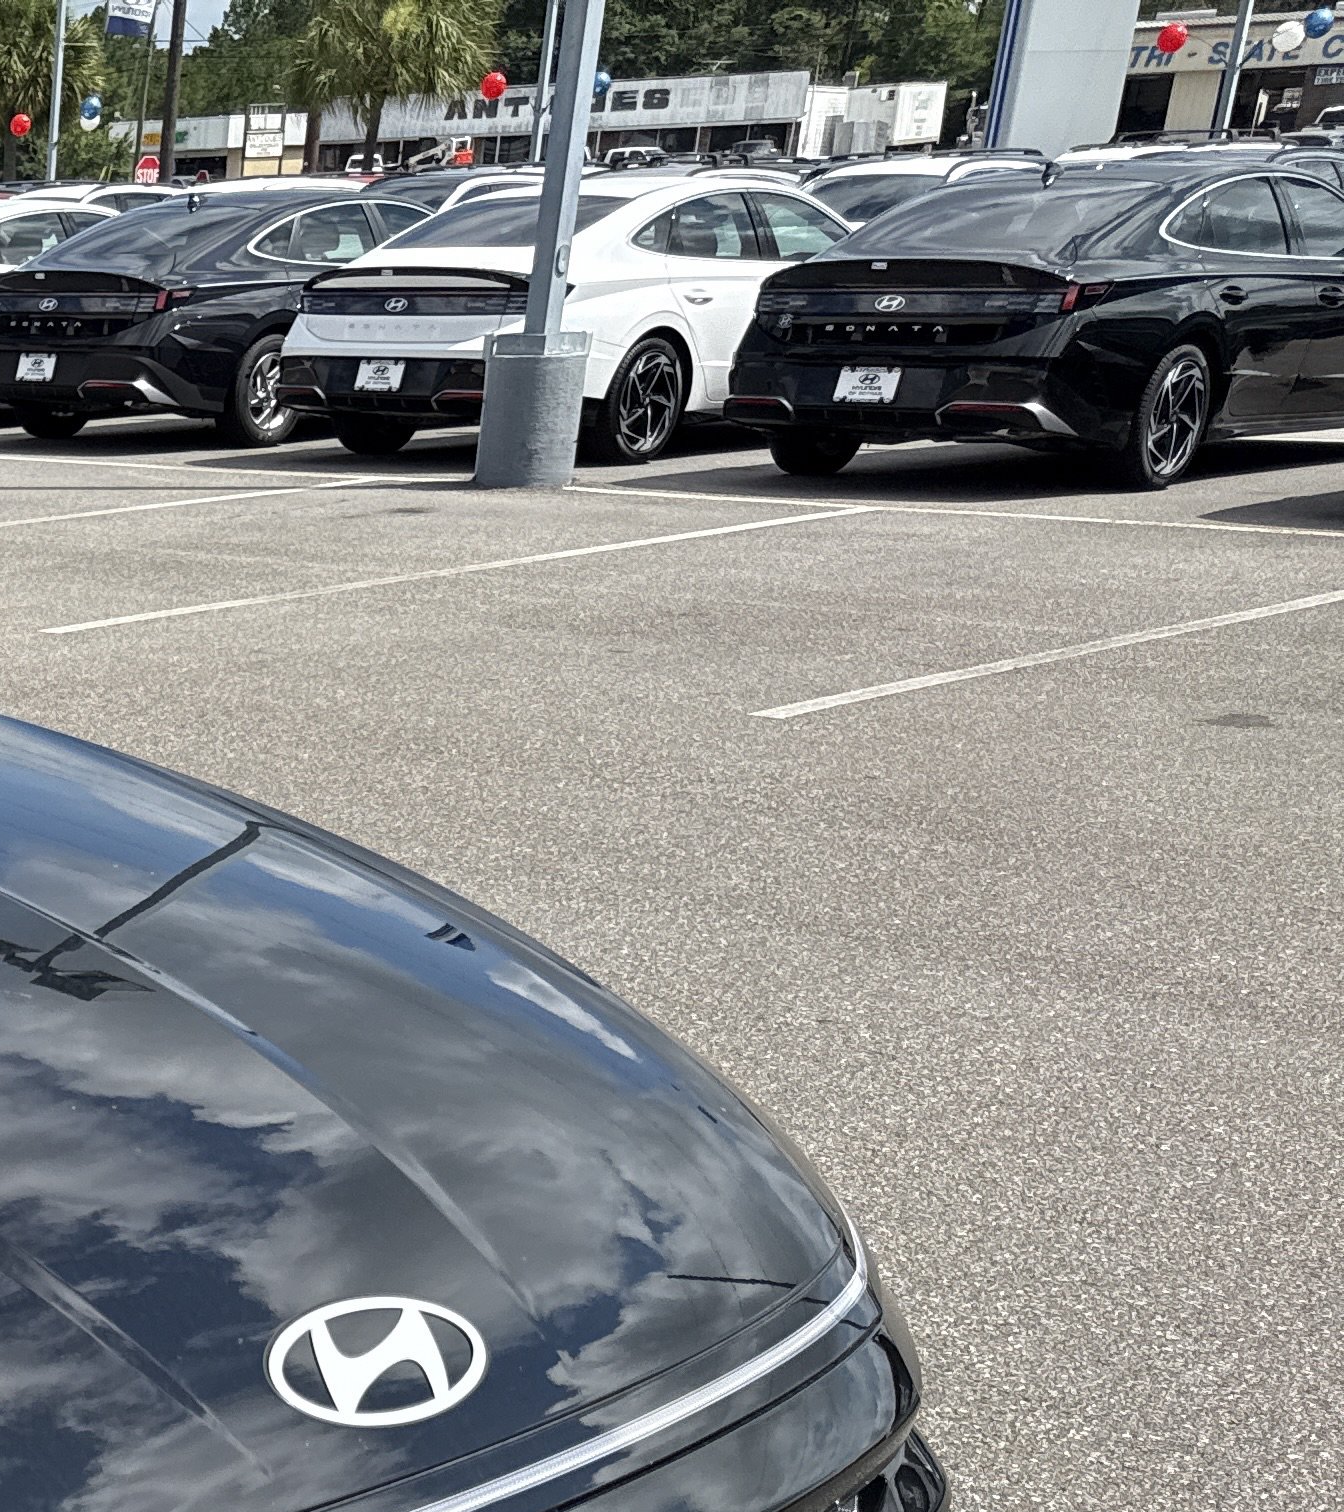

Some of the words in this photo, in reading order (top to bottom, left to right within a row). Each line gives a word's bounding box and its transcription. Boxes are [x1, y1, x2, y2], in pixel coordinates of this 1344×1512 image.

[444, 88, 671, 121] ANTES
[136, 168, 160, 184] STOP
[824, 324, 944, 332] SONATA
